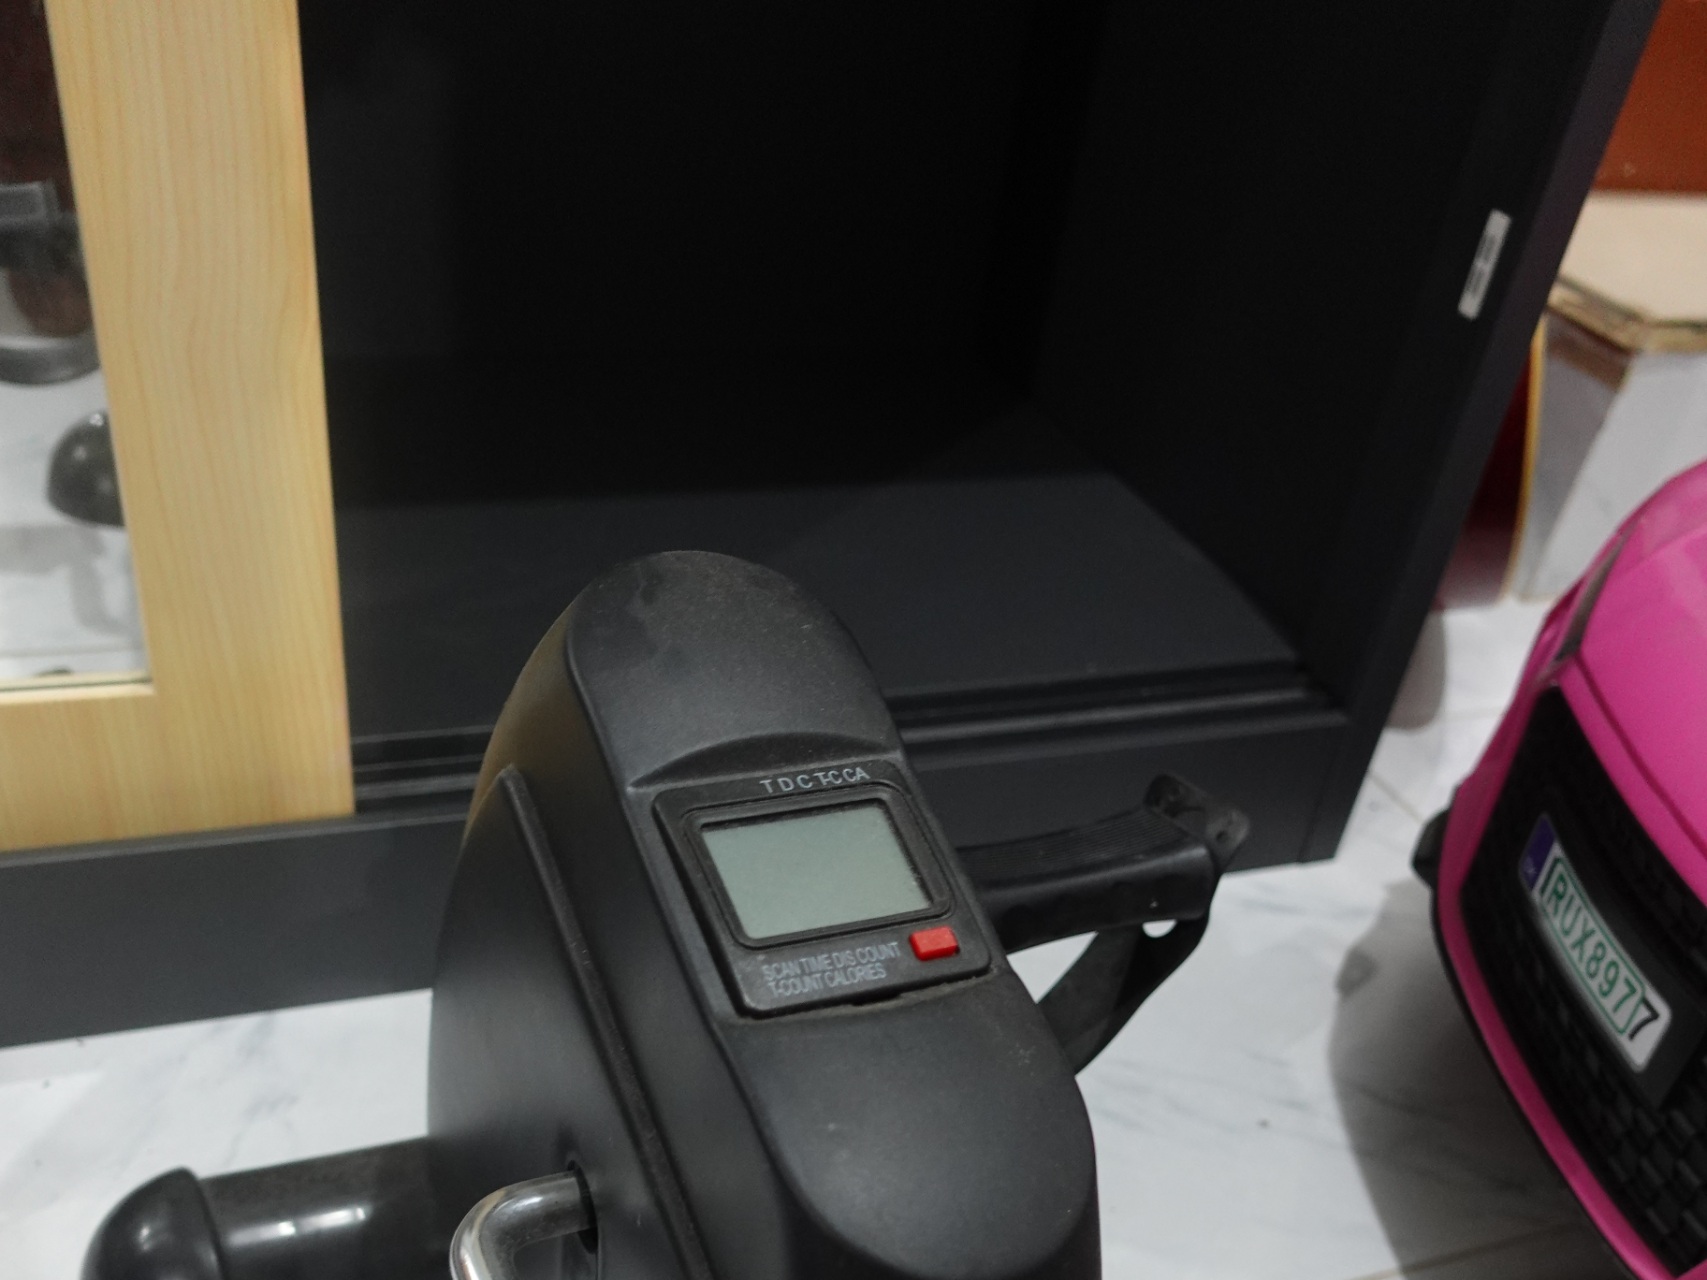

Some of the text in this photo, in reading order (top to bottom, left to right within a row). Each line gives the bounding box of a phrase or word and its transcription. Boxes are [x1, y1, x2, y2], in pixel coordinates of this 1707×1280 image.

[759, 779, 774, 794] T
[777, 777, 795, 792] D
[796, 774, 814, 789] C
[762, 961, 801, 981] SCAN
[799, 954, 833, 974] TIME
[856, 942, 901, 964] COUNT
[823, 962, 887, 987] CALORIES
